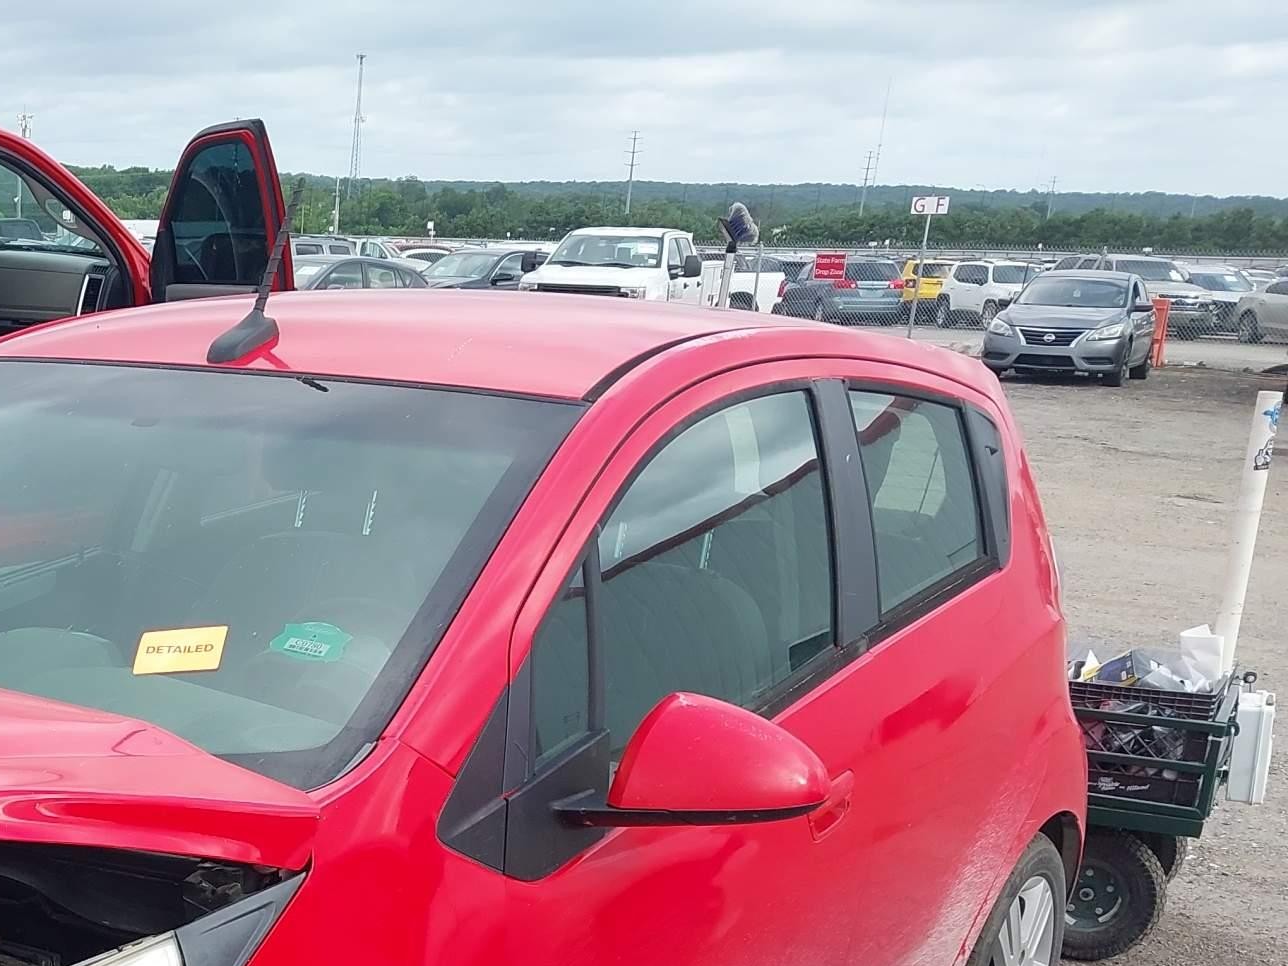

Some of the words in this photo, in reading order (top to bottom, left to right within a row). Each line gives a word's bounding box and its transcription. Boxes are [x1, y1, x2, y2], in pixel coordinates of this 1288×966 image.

[914, 197, 926, 213] G
[935, 197, 946, 213] F
[815, 268, 830, 276] Drop
[146, 644, 214, 654] DETAILED
